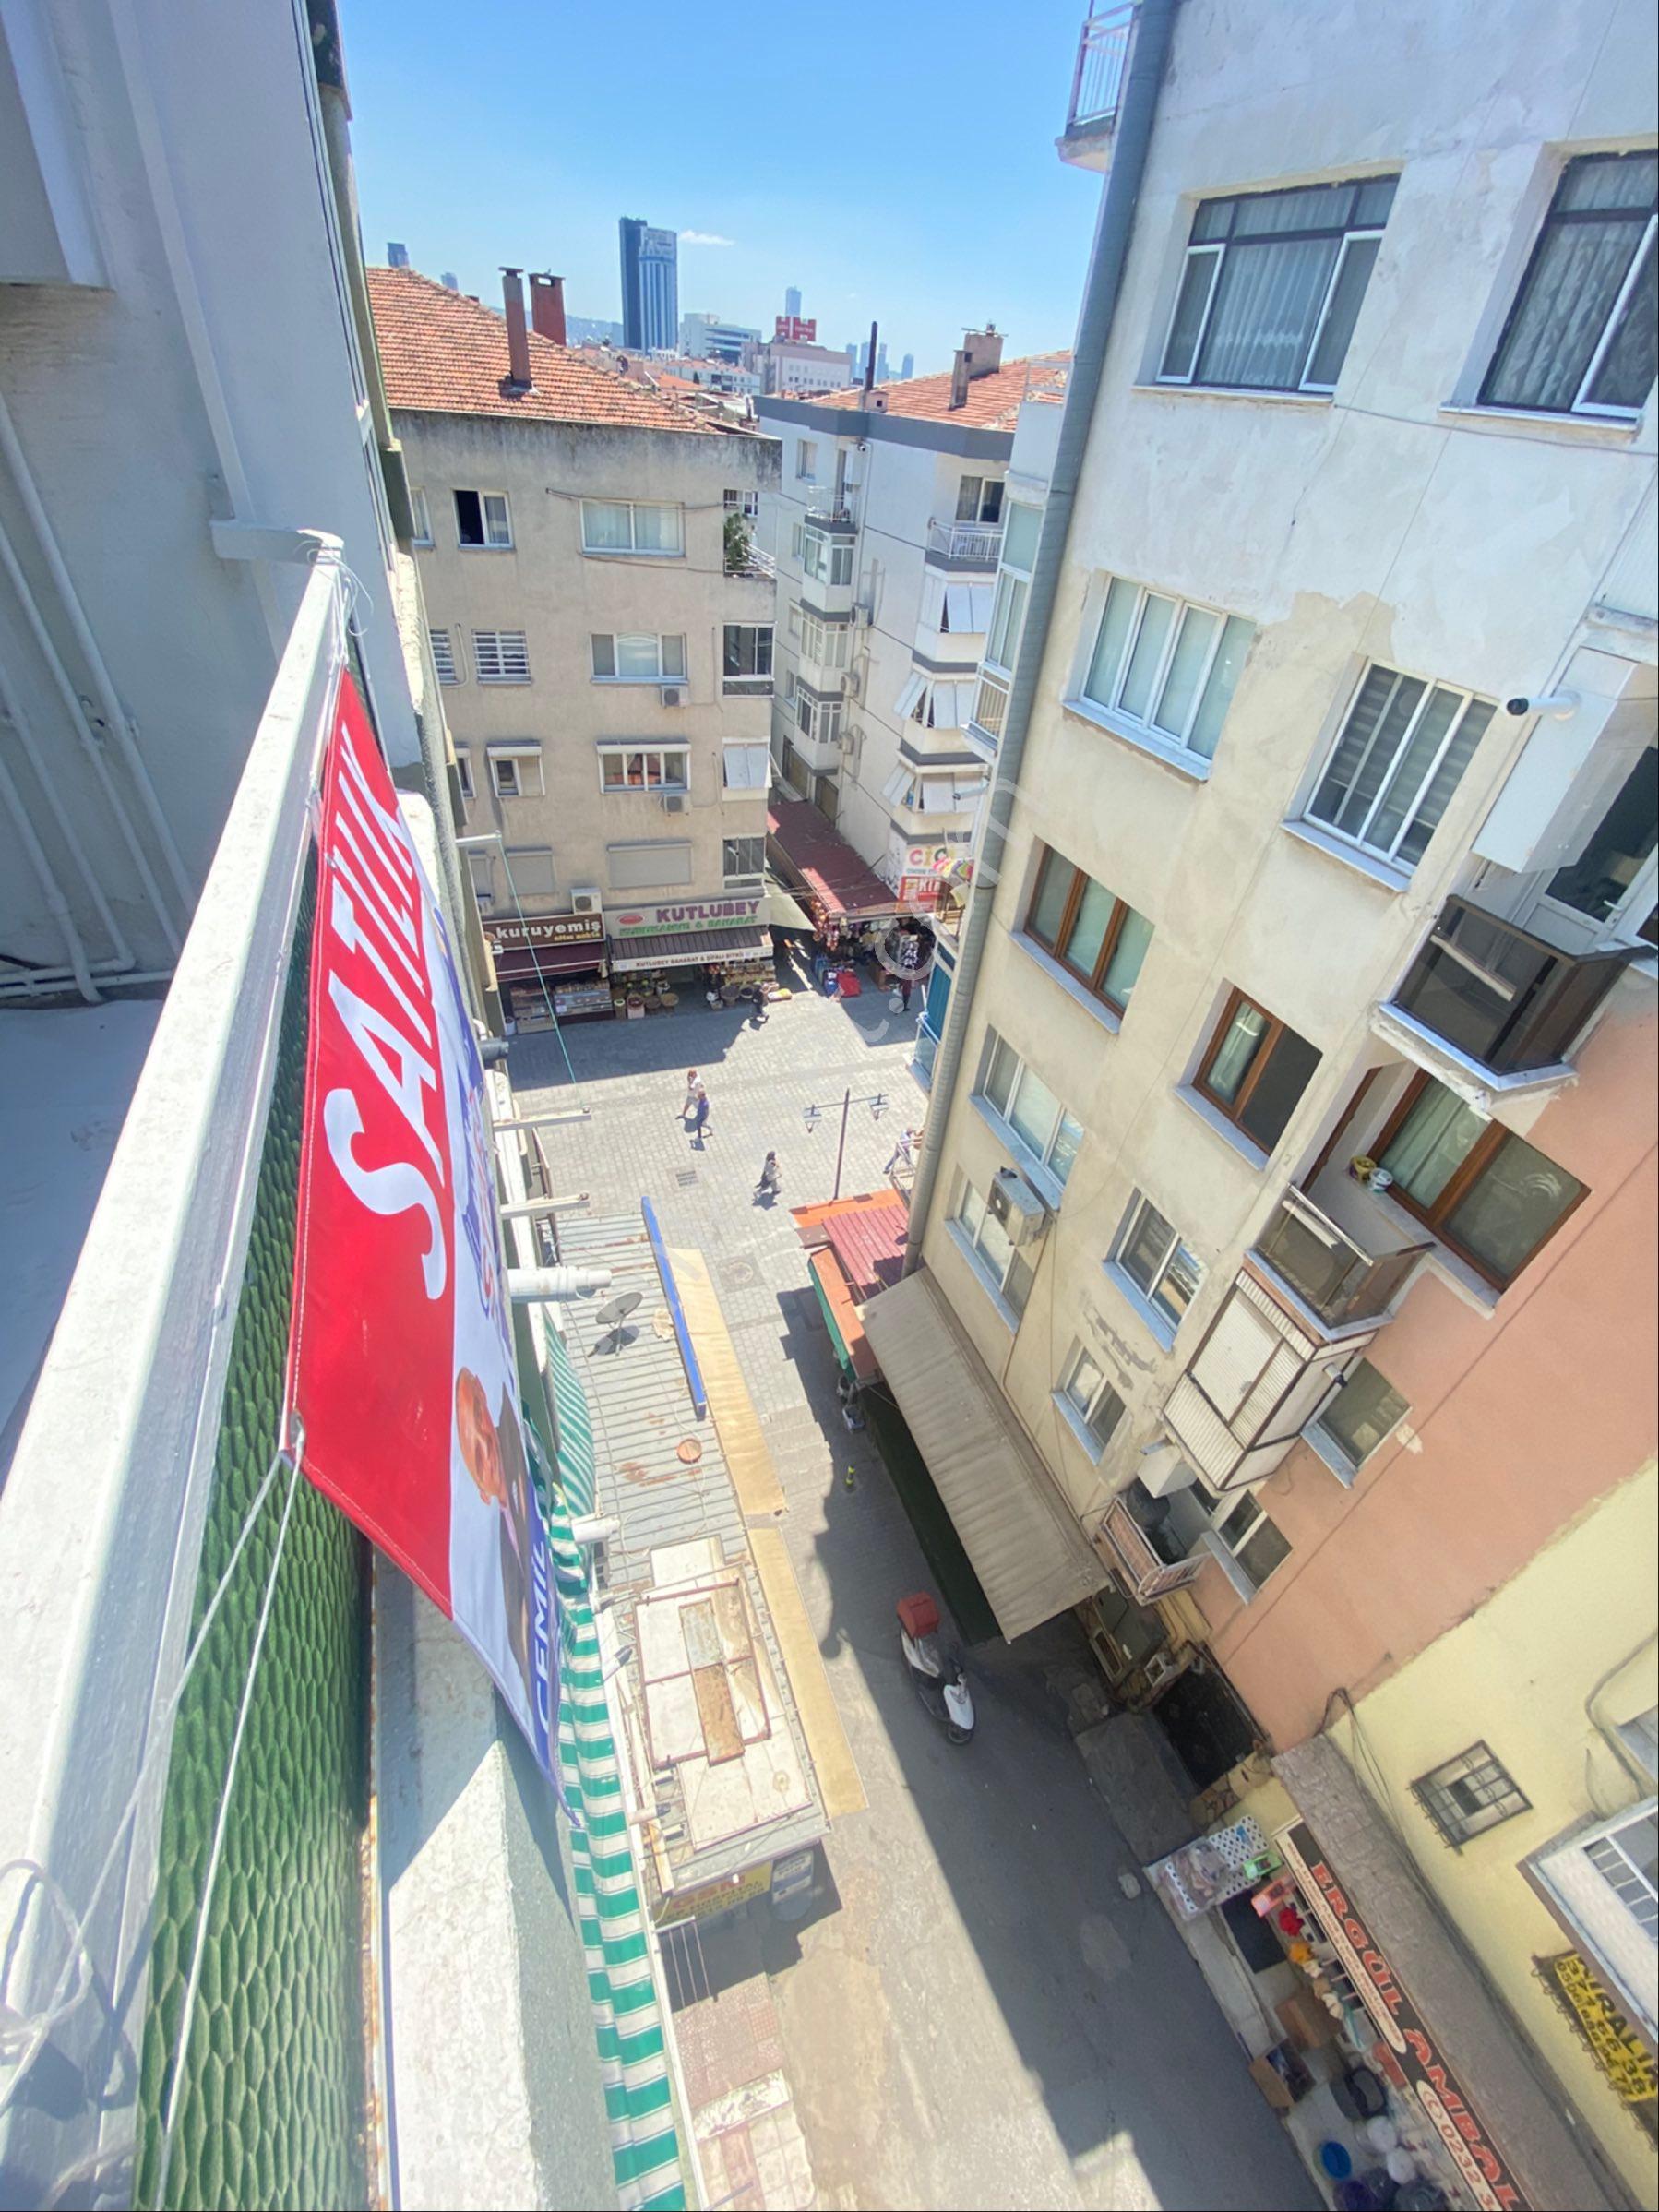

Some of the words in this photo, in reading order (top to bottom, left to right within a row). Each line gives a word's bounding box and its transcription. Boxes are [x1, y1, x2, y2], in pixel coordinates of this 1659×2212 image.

[496, 919, 601, 939] kuruyemiş
[656, 900, 760, 923] KUTLUBEY
[323, 721, 447, 1300] SATILIK
[1310, 1860, 1402, 2015] ERGÜL
[1441, 2124, 1481, 2184] 0232
